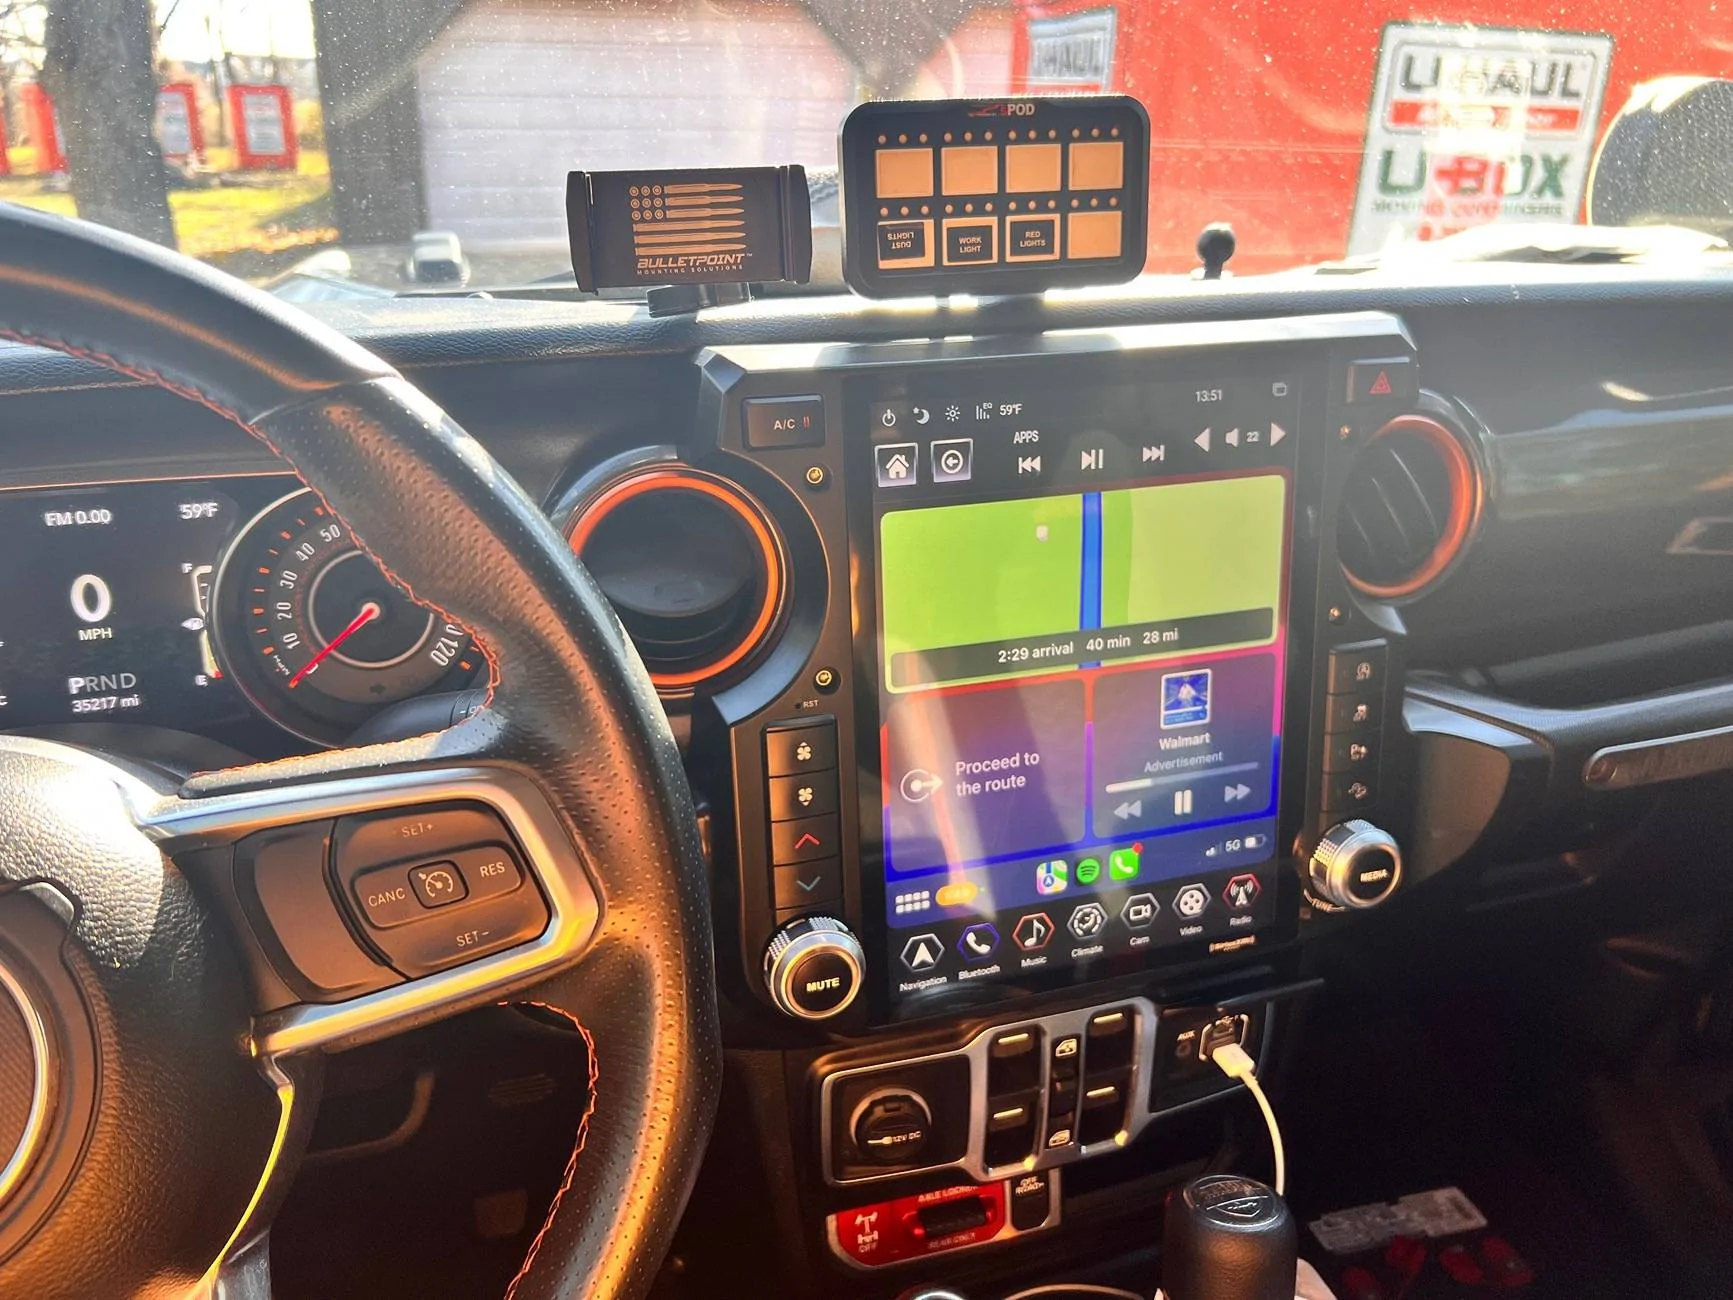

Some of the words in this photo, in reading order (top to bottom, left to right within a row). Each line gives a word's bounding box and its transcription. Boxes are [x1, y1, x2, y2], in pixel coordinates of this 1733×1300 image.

[958, 236, 982, 245] WORK
[1025, 231, 1041, 239] RED
[959, 245, 982, 254] LIGHT
[1019, 239, 1046, 248] LIGHTS
[637, 254, 745, 269] BULLETPOINT
[636, 267, 686, 276] MOUNTING
[691, 264, 743, 273] SOLUTIONS
[1195, 389, 1223, 402] 13:51
[774, 418, 796, 430] A/C
[1013, 430, 1039, 444] APPS
[1246, 431, 1261, 443] 22
[44, 511, 73, 527] FM
[75, 508, 113, 525] 0.00
[320, 524, 341, 543] 50
[295, 542, 316, 562] 40
[280, 570, 298, 590] 30
[70, 574, 112, 622] 0
[276, 601, 293, 620] 20
[78, 627, 113, 641] MPH
[282, 632, 301, 650] 10
[431, 637, 459, 667] 120
[998, 647, 1029, 663] 2:29
[1032, 641, 1074, 659] arrival
[1086, 637, 1104, 651] 40
[1106, 634, 1131, 649] min
[1142, 631, 1160, 645] 28
[1162, 628, 1179, 641] mi
[72, 696, 117, 713] 35217
[120, 694, 141, 708] mi
[803, 699, 819, 709] RST
[1158, 732, 1211, 751] Walmart
[955, 753, 1020, 776] Proceed
[1022, 752, 1040, 767] to
[1144, 750, 1223, 773] Advertisement
[956, 780, 981, 797] the
[985, 774, 1026, 793] route
[1225, 839, 1241, 852] 5G
[480, 862, 506, 878] RES
[368, 887, 406, 908] CANC
[1230, 916, 1253, 927] Radio
[1179, 924, 1203, 938] Video
[1129, 935, 1151, 947] Cam
[1071, 944, 1104, 959] Climate
[1021, 955, 1048, 969] Music
[958, 964, 1001, 981] Bluetooth
[806, 977, 840, 993] MUTE
[899, 974, 948, 993] Navigation
